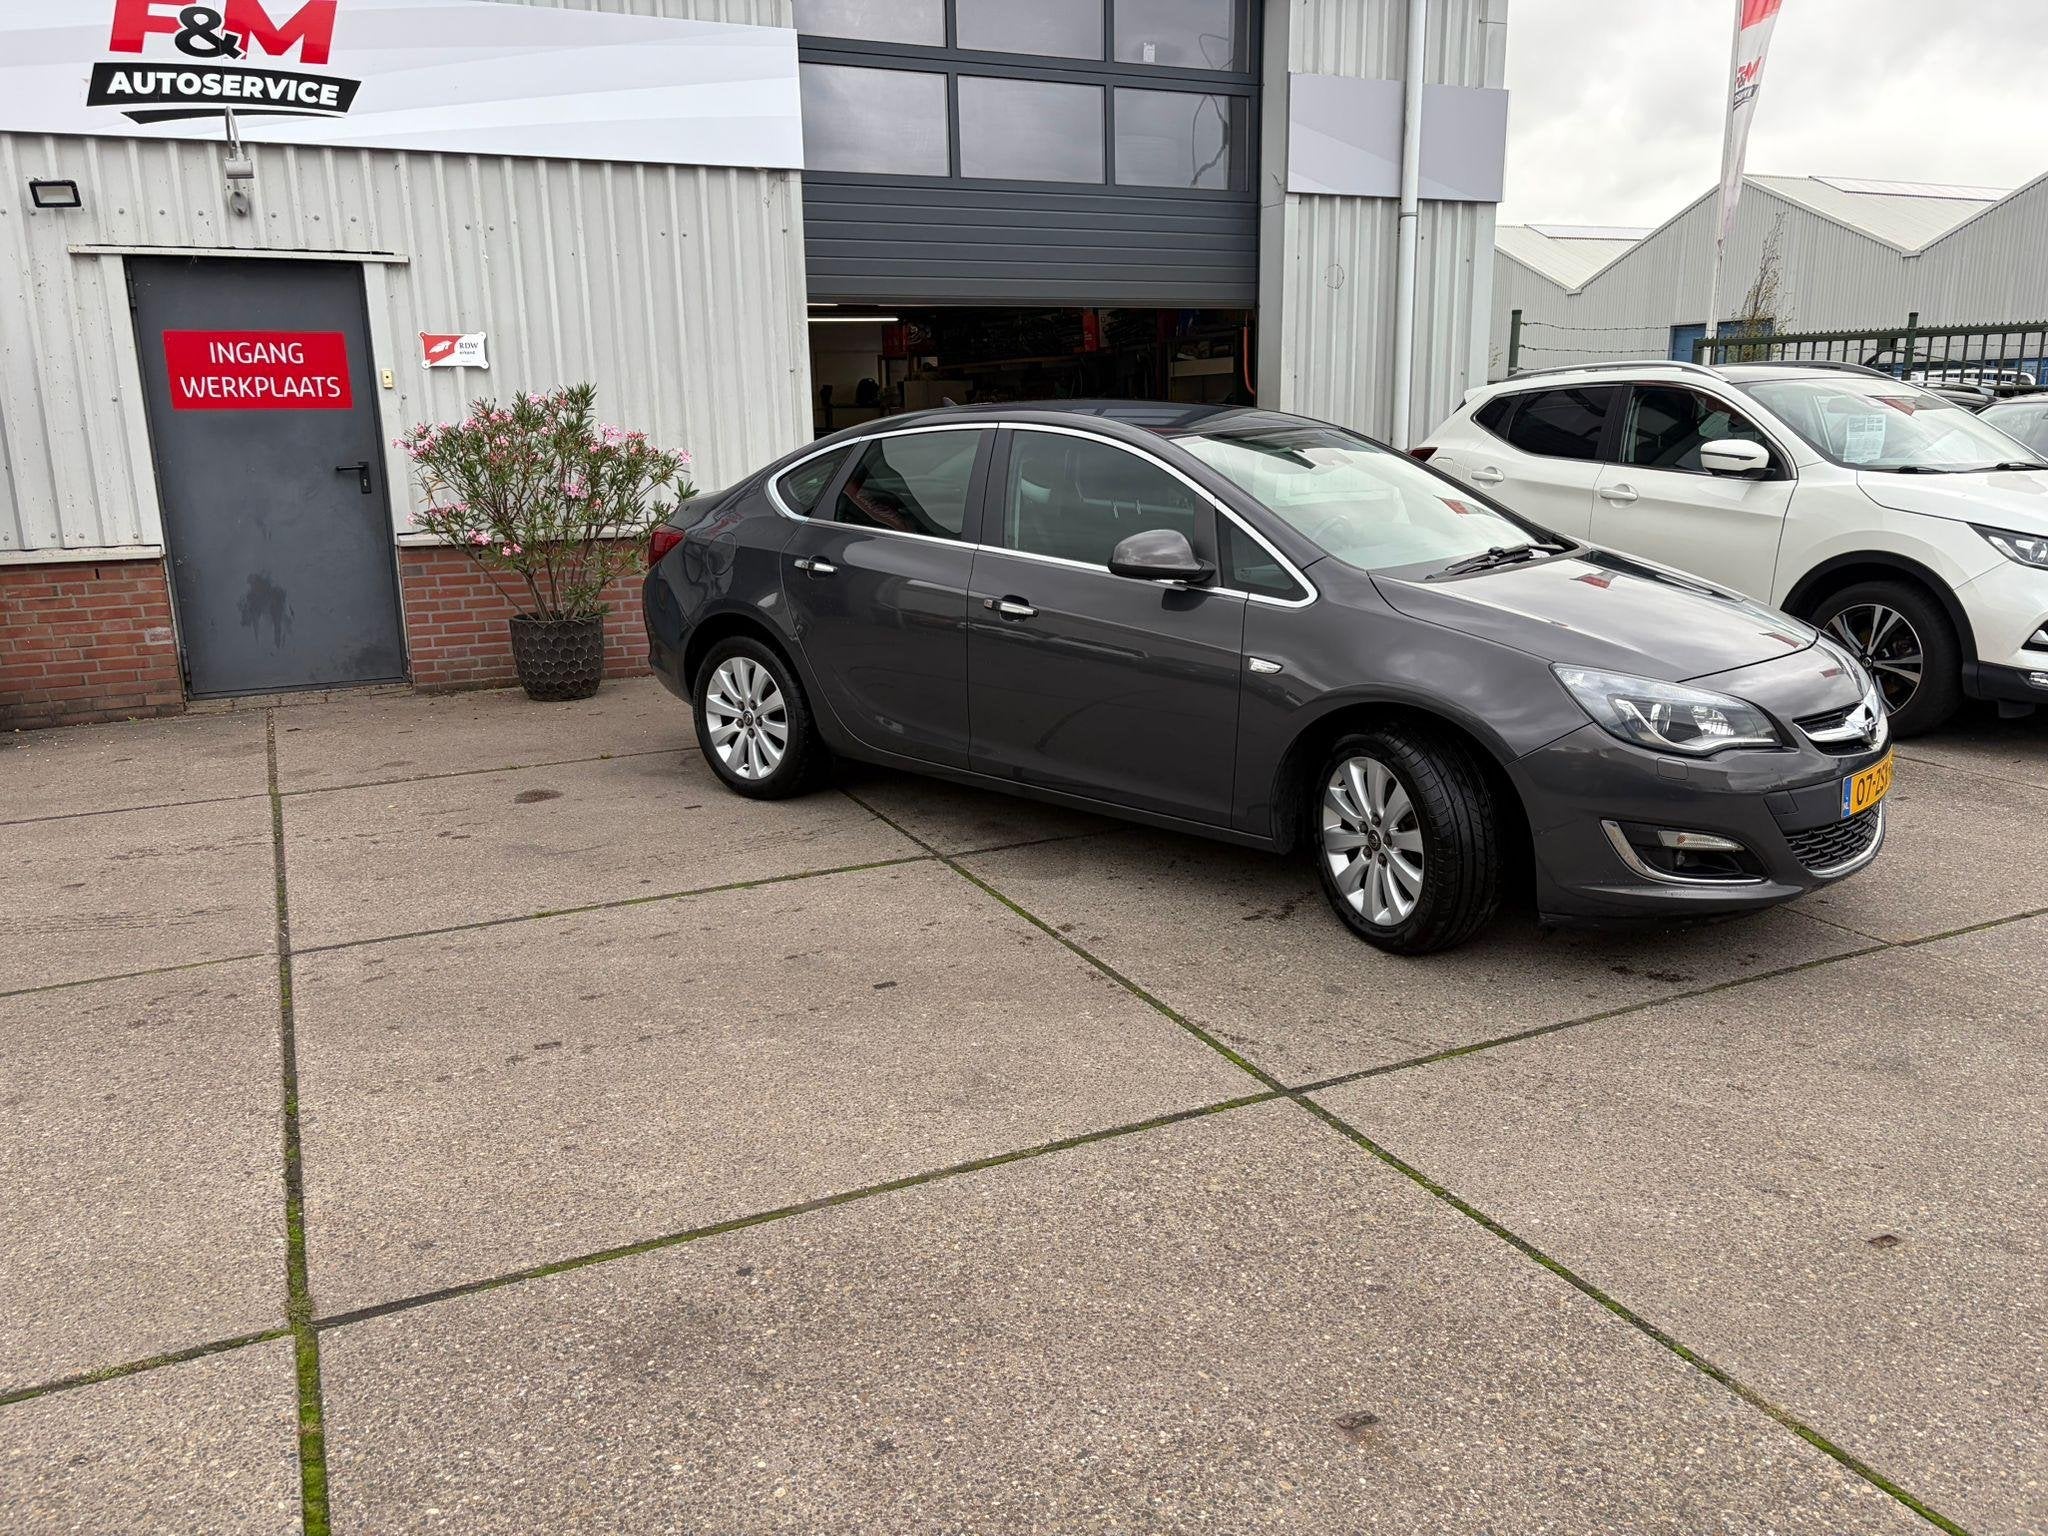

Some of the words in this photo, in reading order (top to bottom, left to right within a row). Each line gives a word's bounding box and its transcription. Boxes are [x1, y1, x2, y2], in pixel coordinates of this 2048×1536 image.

[109, 0, 338, 65] F&M
[106, 71, 341, 107] AUTOSERVICE
[209, 341, 304, 364] INGANG
[179, 376, 342, 398] WERKPLAATS
